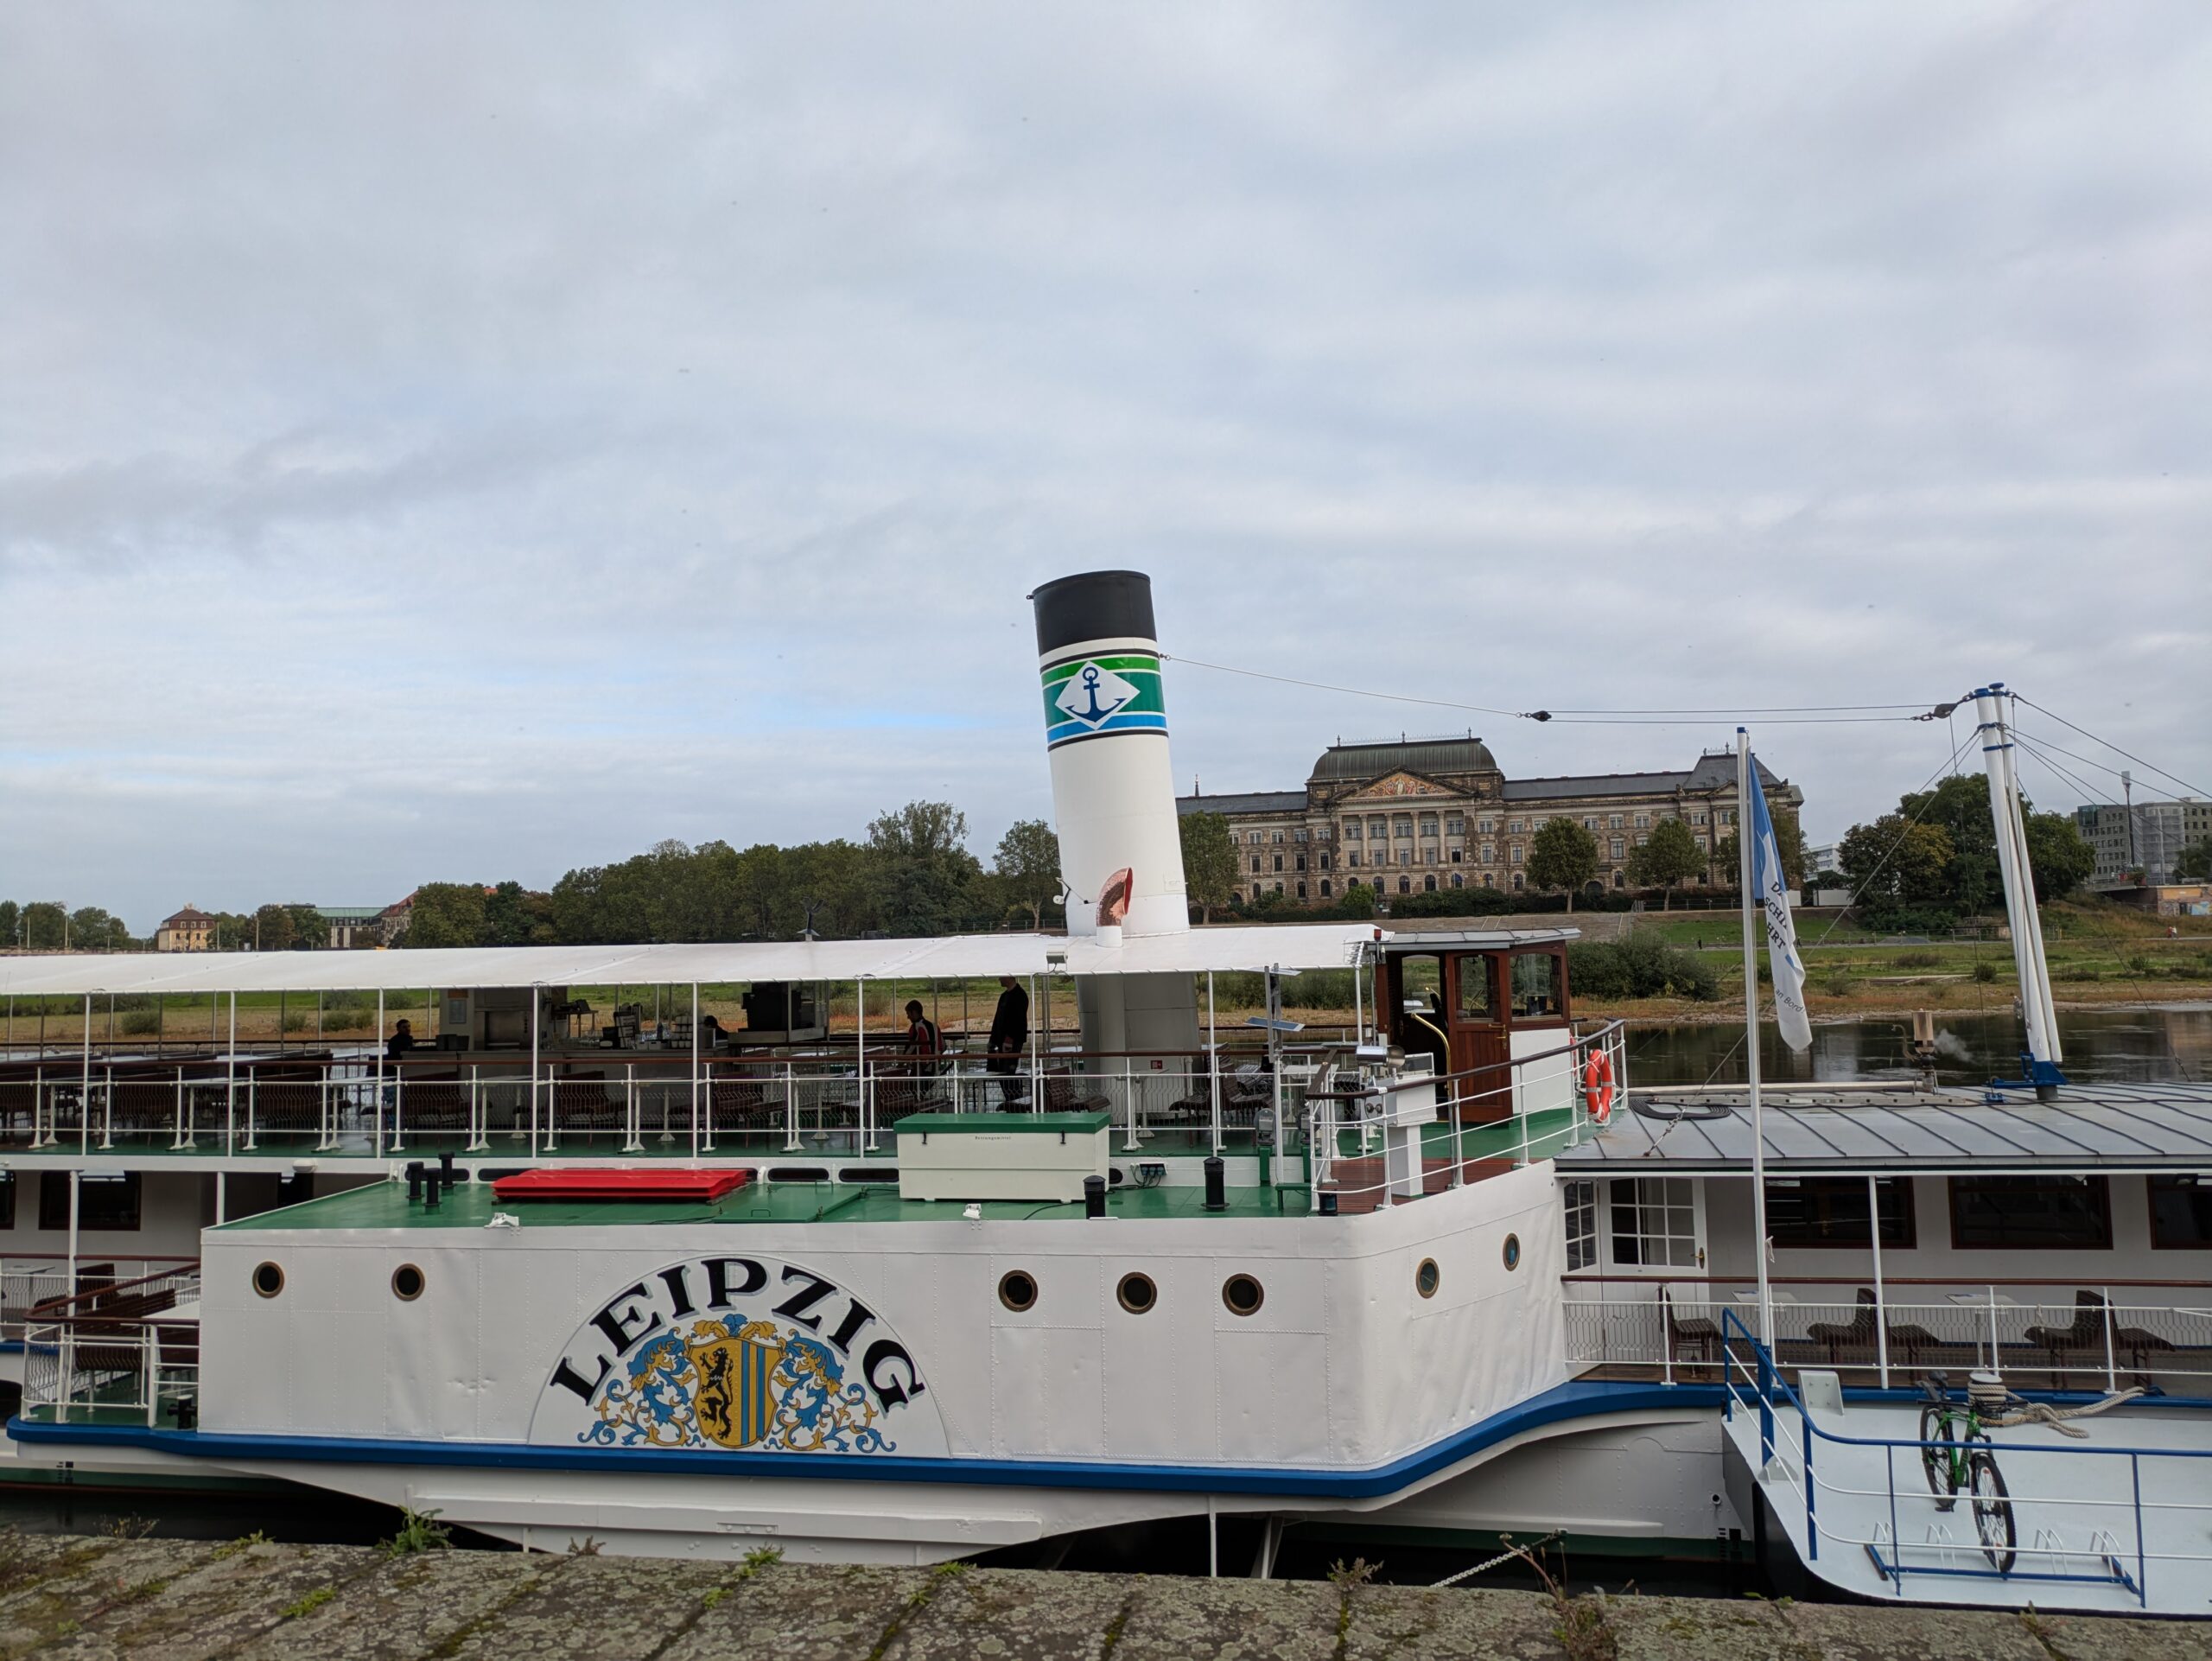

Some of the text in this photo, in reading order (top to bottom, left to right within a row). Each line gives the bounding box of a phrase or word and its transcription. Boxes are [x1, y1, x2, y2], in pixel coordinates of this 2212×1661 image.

[1770, 881, 1782, 896] D
[1764, 896, 1787, 930] SCHI
[550, 1257, 926, 1416] LEIPZIG
